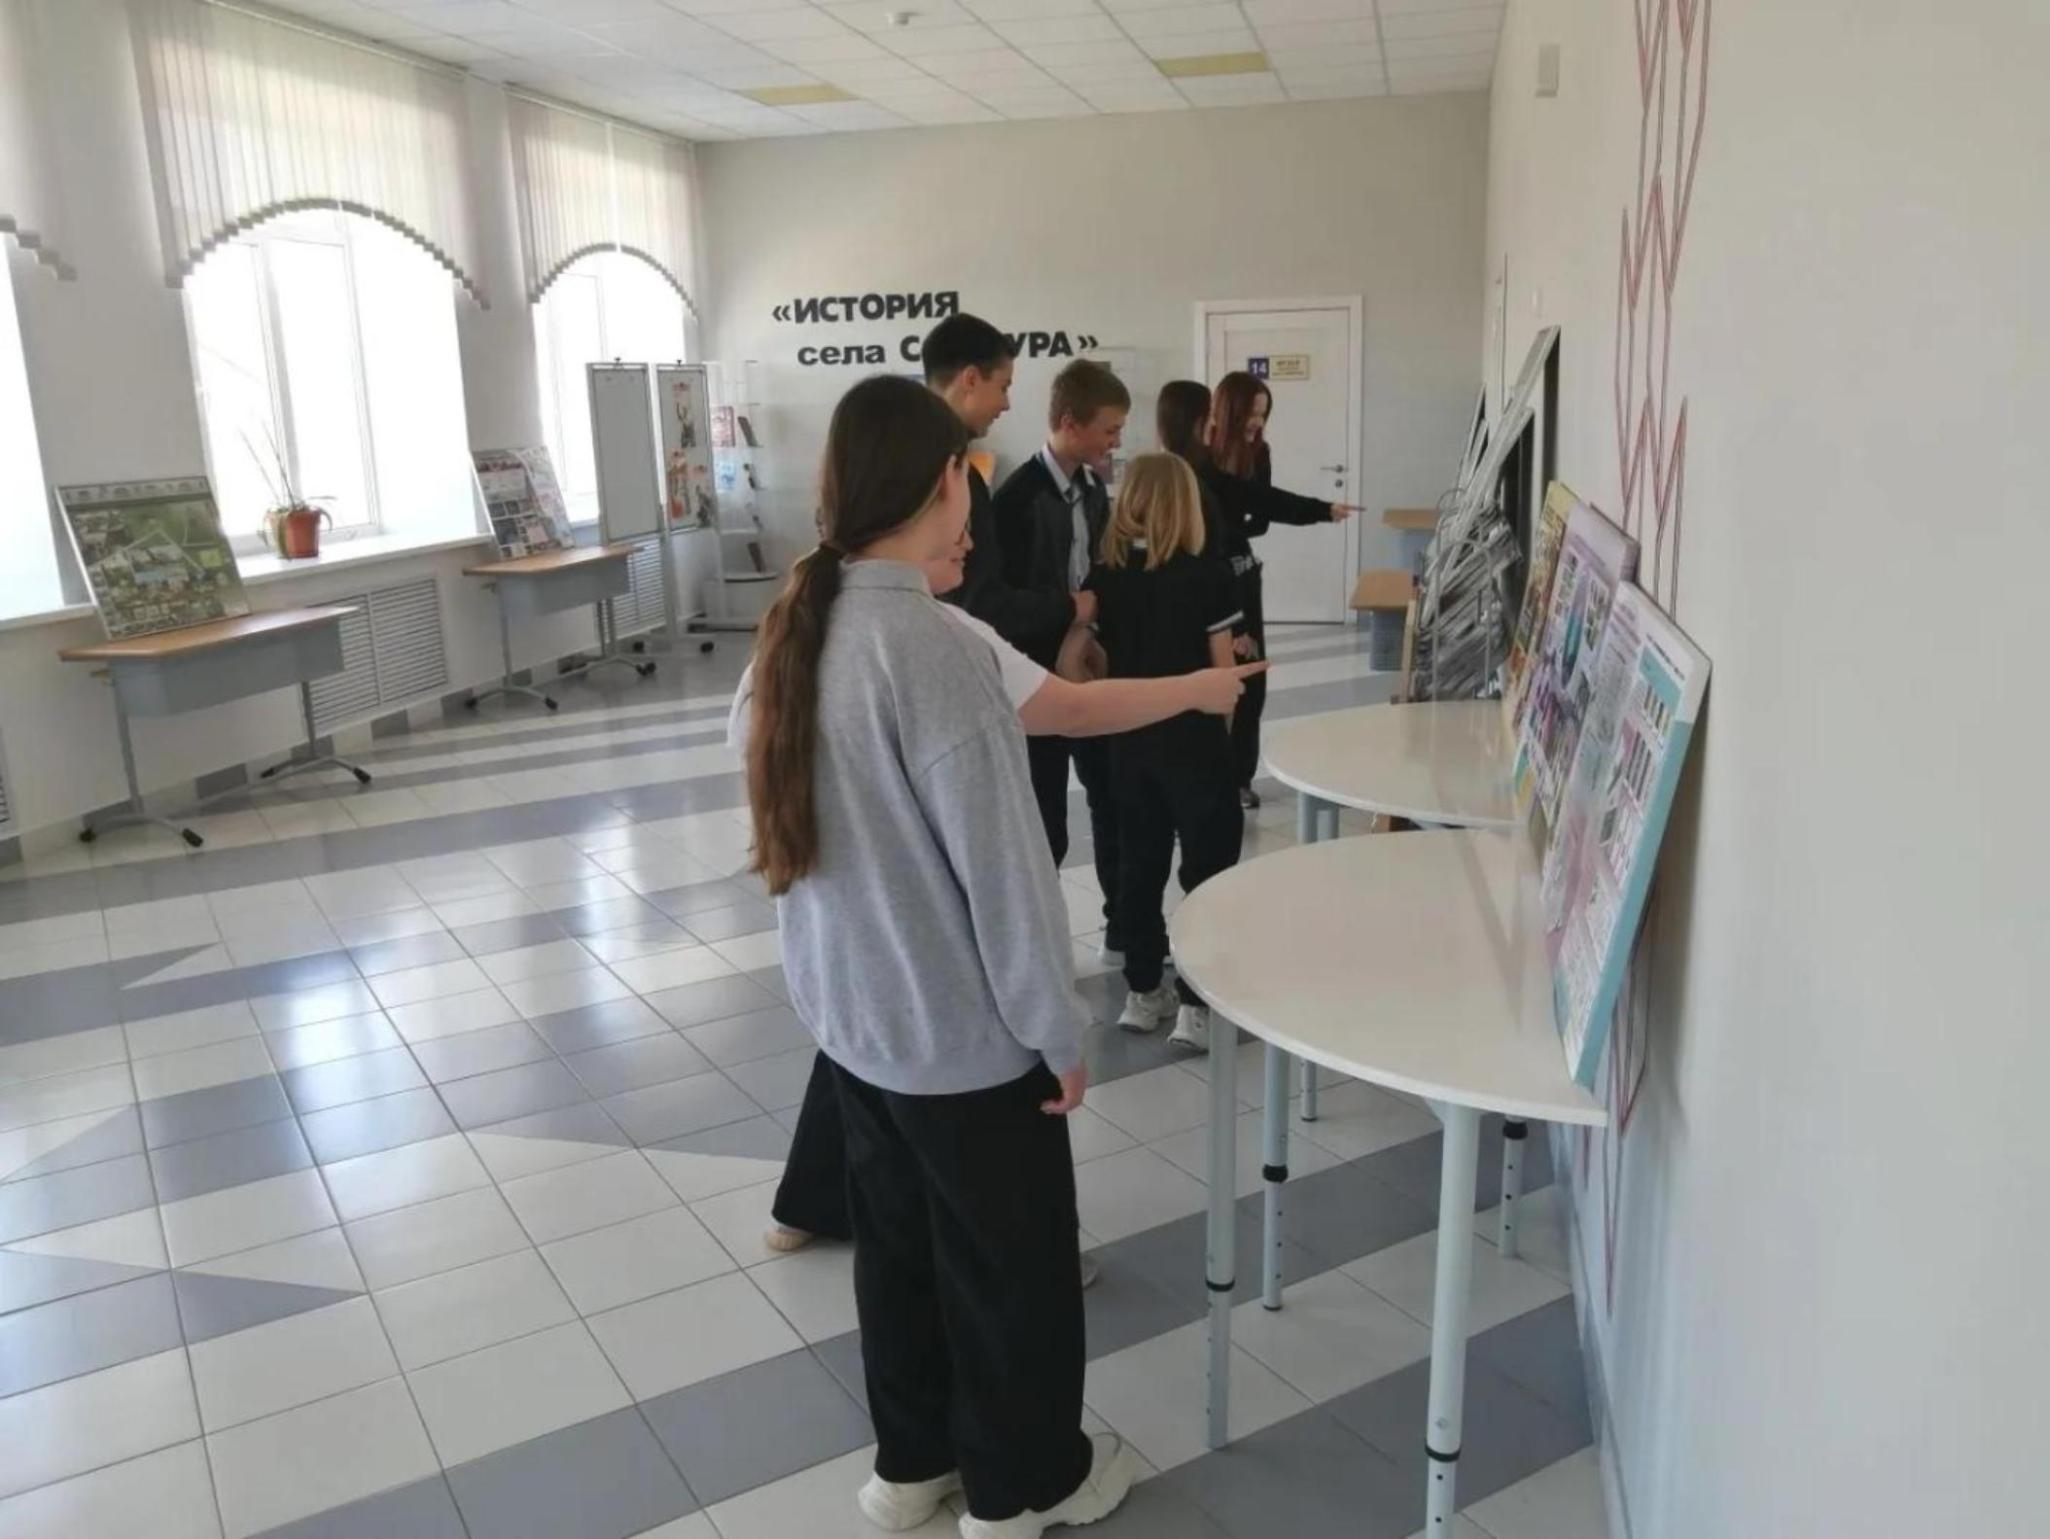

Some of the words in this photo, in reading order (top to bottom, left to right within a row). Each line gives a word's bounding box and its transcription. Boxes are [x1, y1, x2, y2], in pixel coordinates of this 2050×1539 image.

[772, 291, 959, 323] «ИСТОРИЯ
[798, 344, 886, 365] села
[1251, 361, 1267, 374] 14
